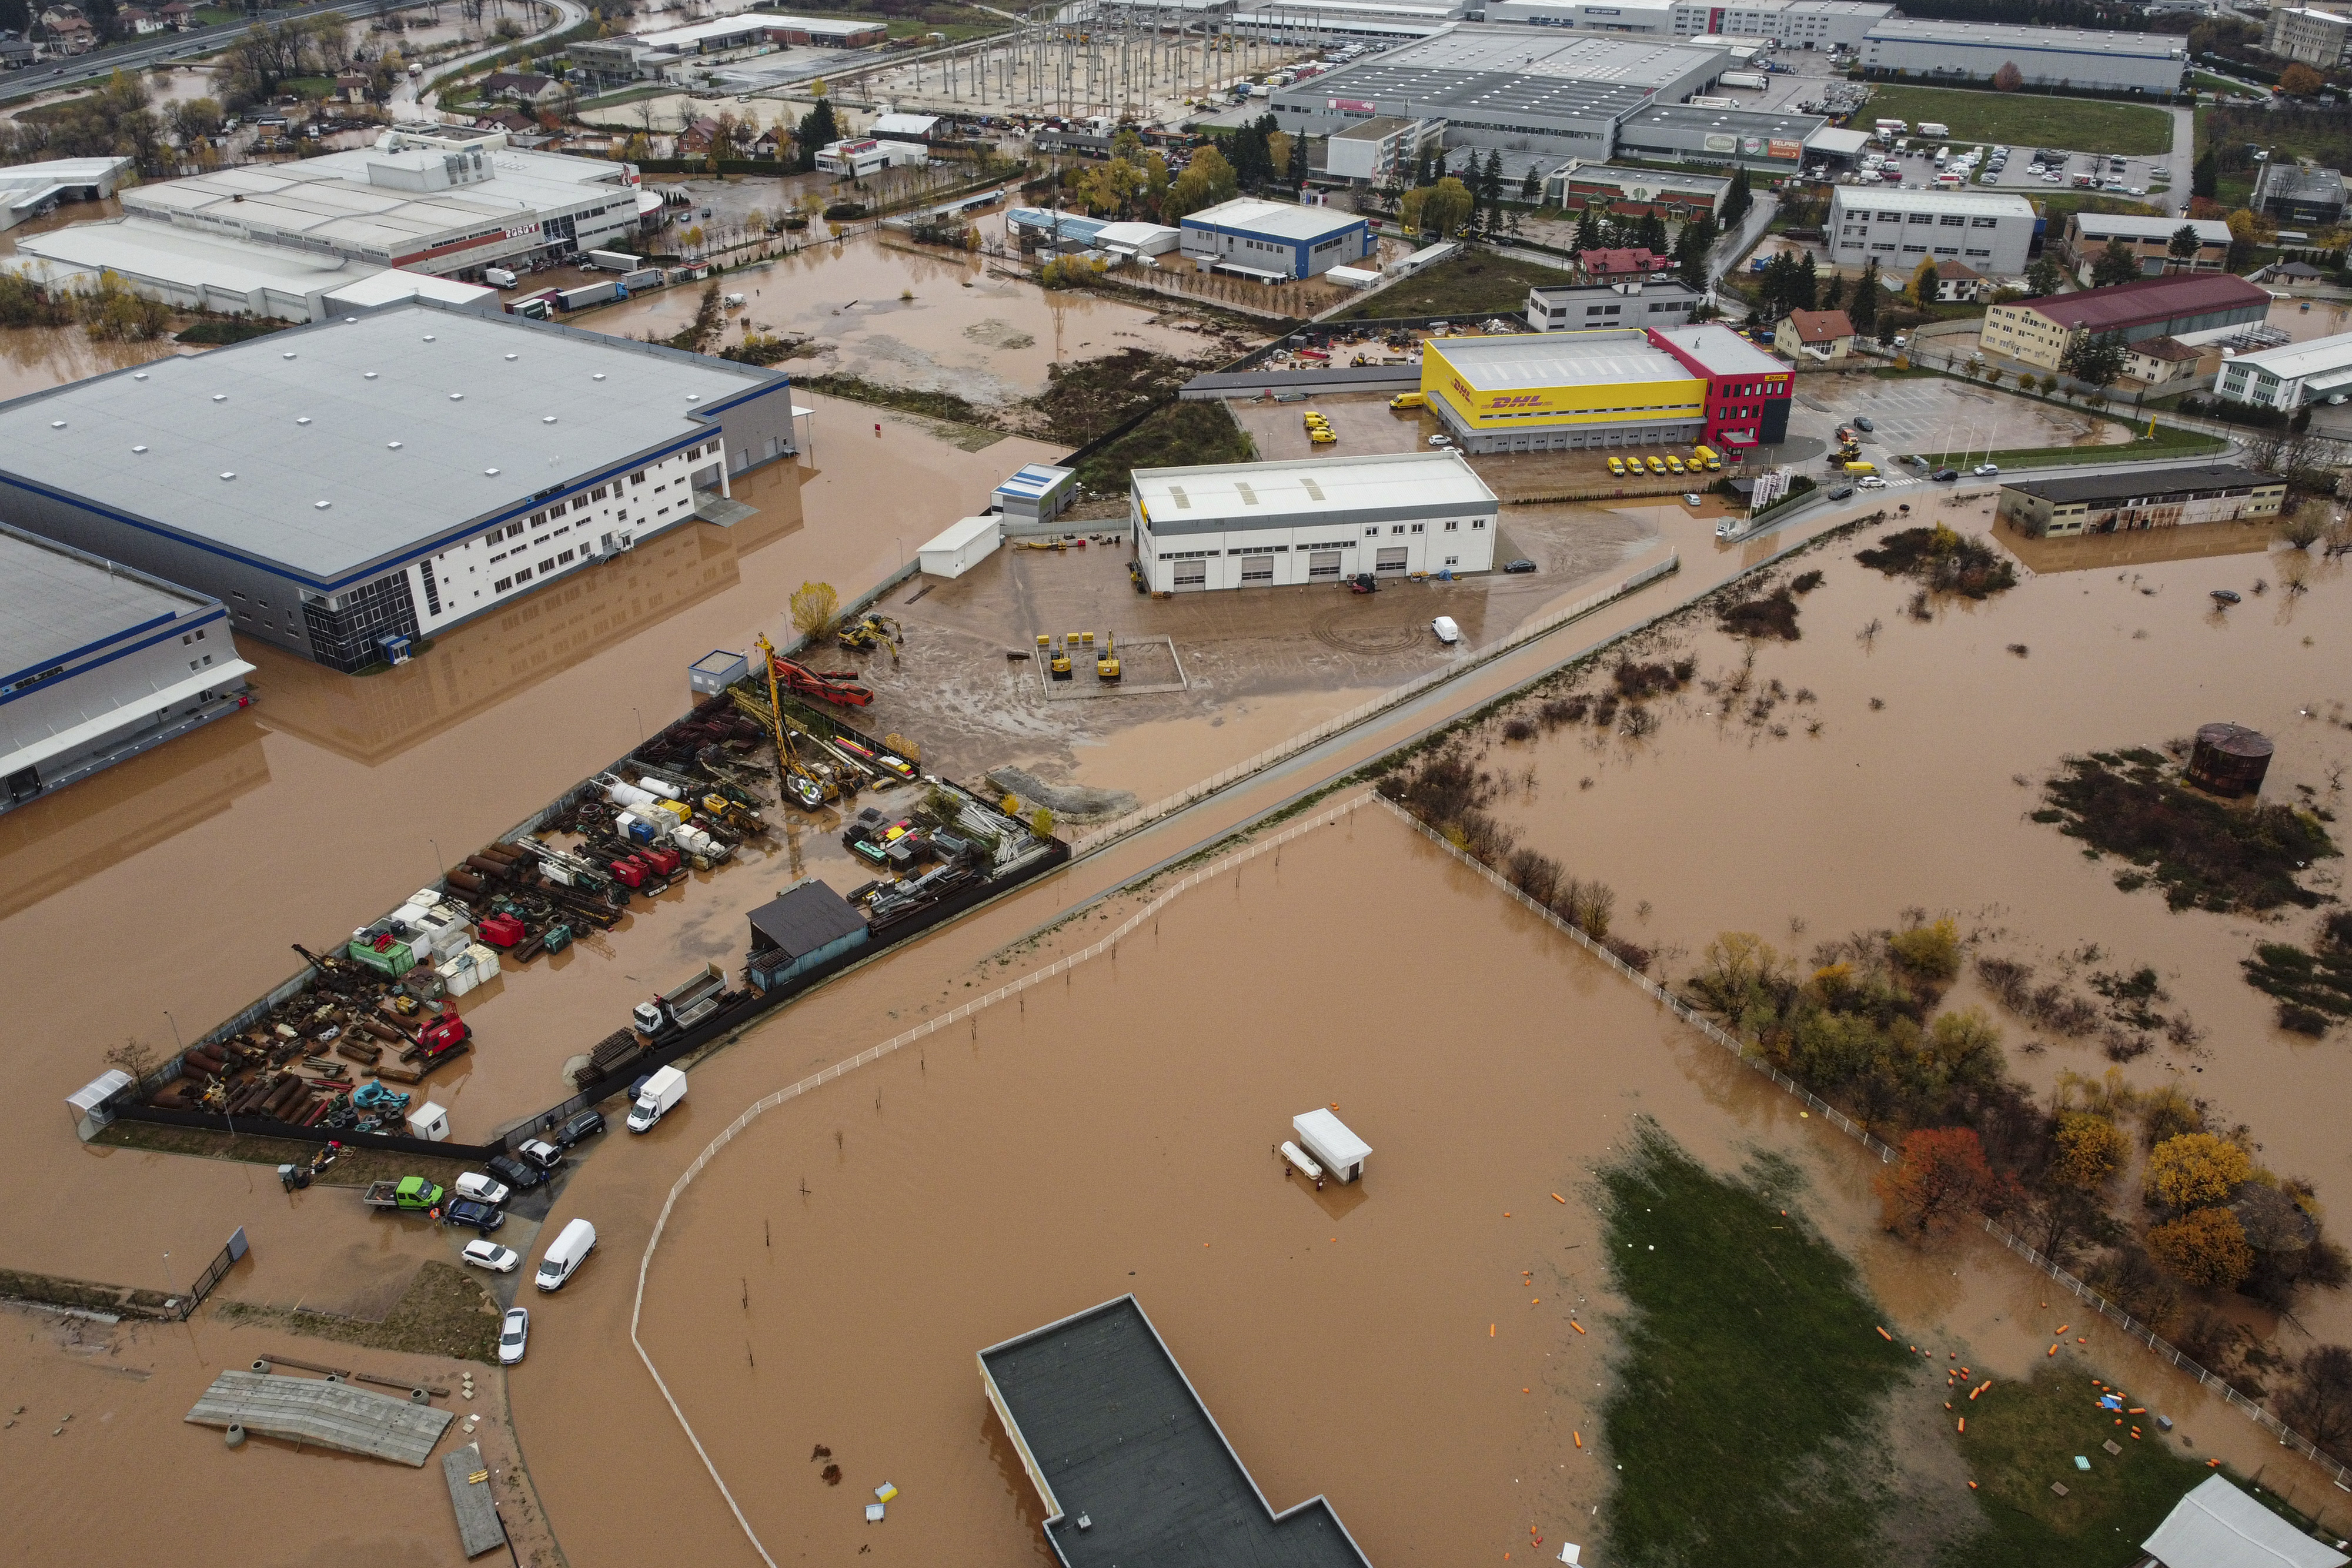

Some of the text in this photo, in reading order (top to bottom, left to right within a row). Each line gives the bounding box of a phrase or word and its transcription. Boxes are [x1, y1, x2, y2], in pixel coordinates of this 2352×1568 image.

[505, 223, 537, 239] ROBOT
[1454, 377, 1471, 403] DHL
[1491, 395, 1543, 409] DHL
[534, 484, 566, 500] SELZER
[15, 666, 64, 689] SELZER
